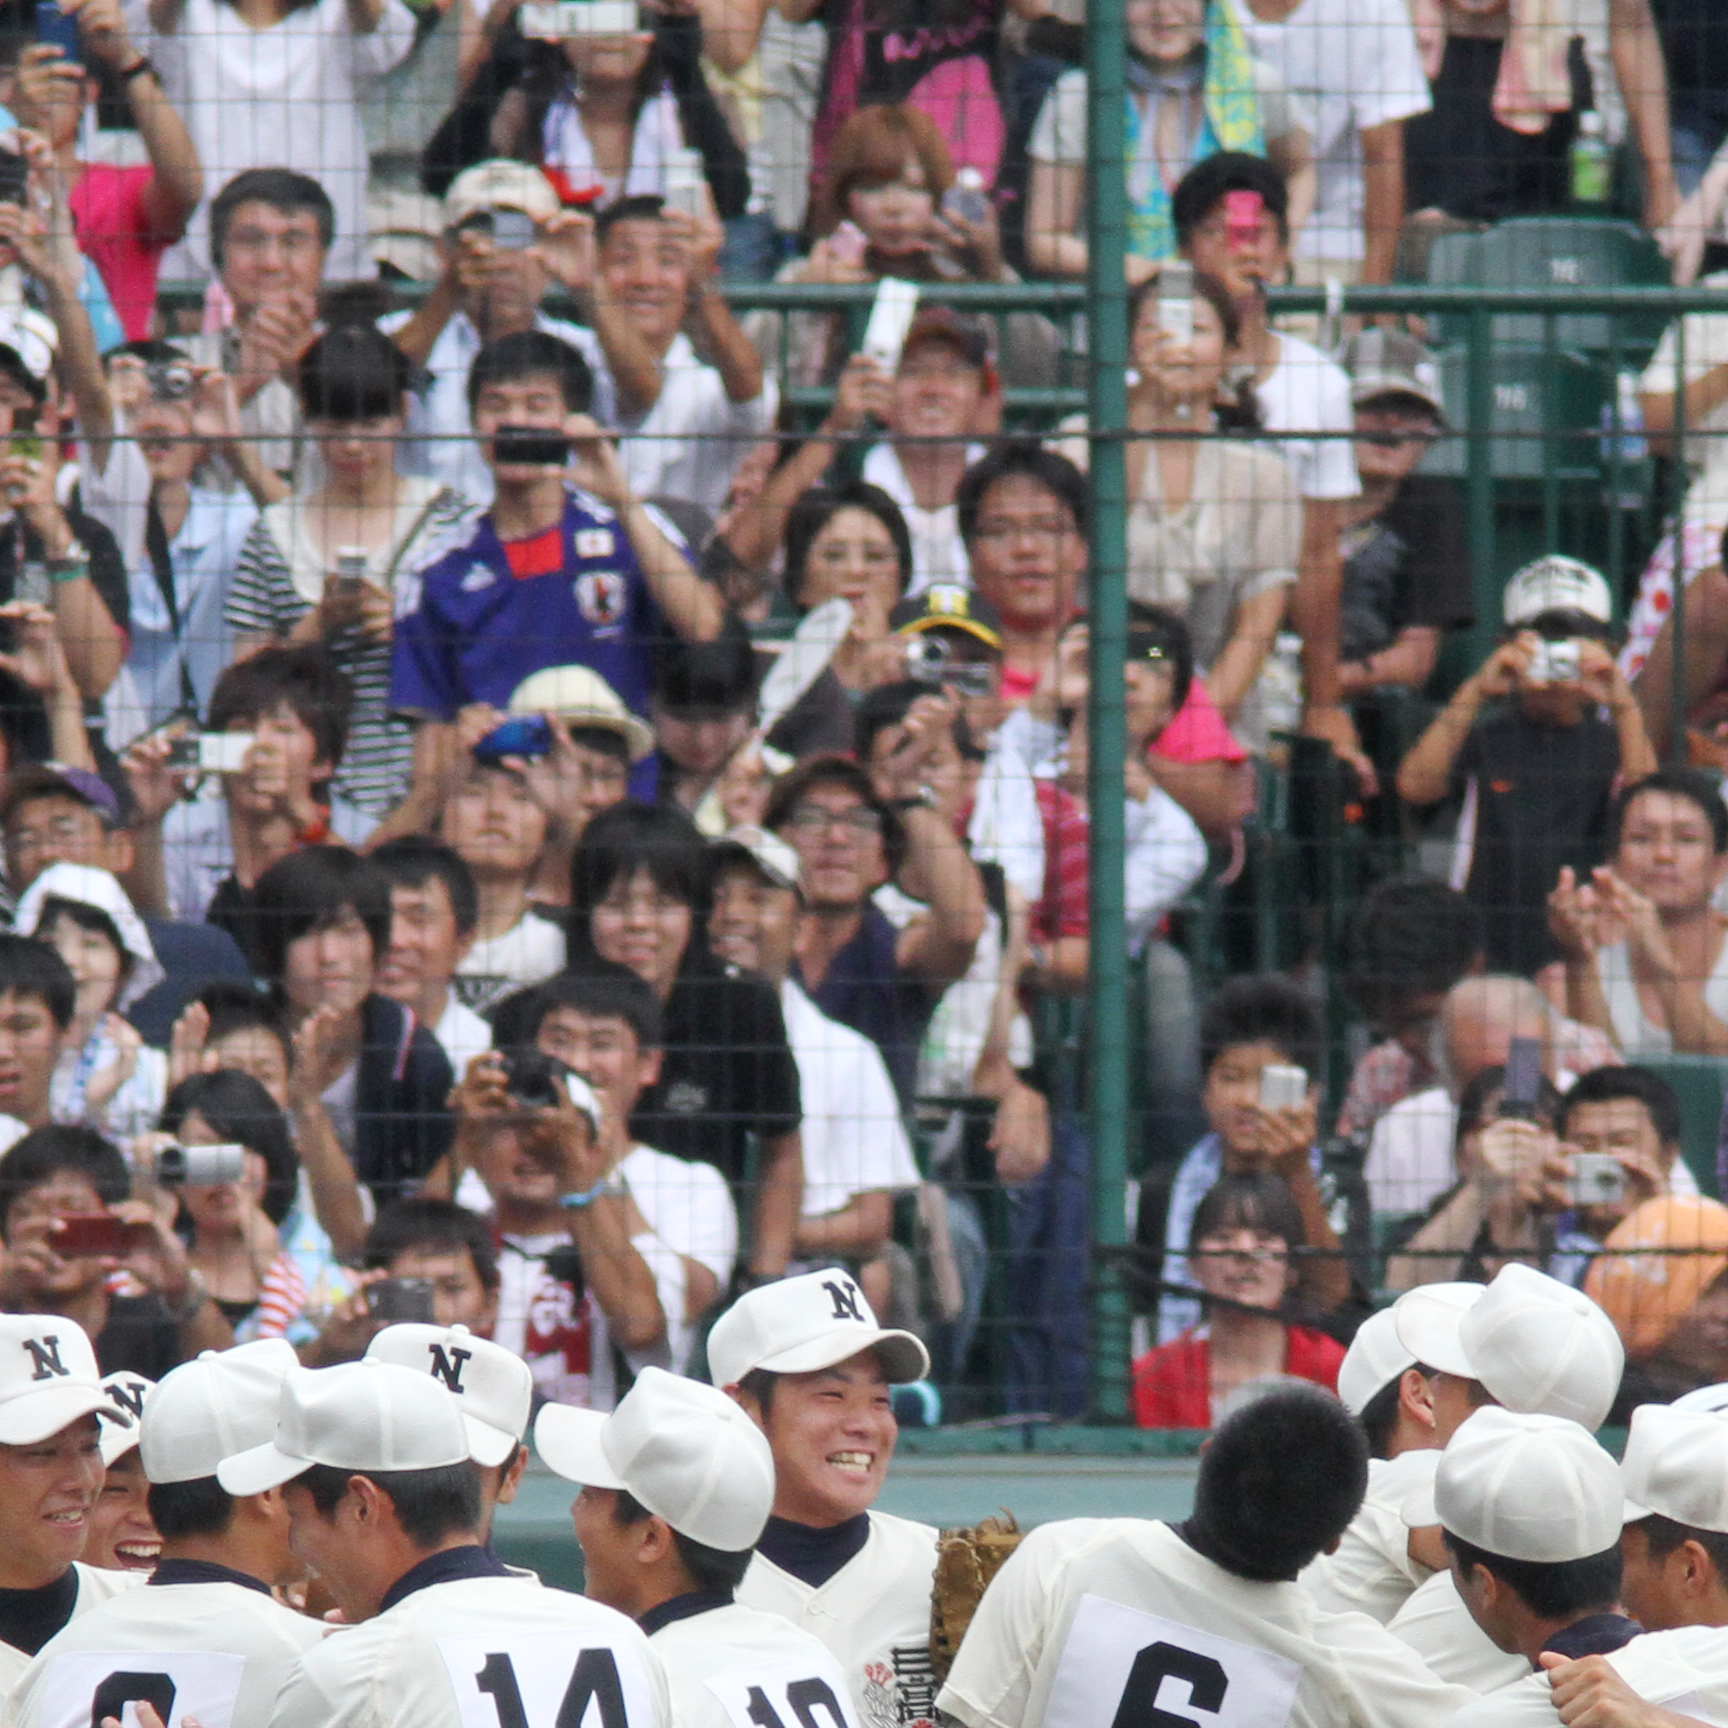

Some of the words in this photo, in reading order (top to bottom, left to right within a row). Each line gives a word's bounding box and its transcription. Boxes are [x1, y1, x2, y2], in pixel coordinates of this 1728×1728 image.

[821, 1280, 866, 1322] N
[23, 1336, 62, 1380] N
[429, 1342, 472, 1394] N
[103, 1381, 146, 1420] N
